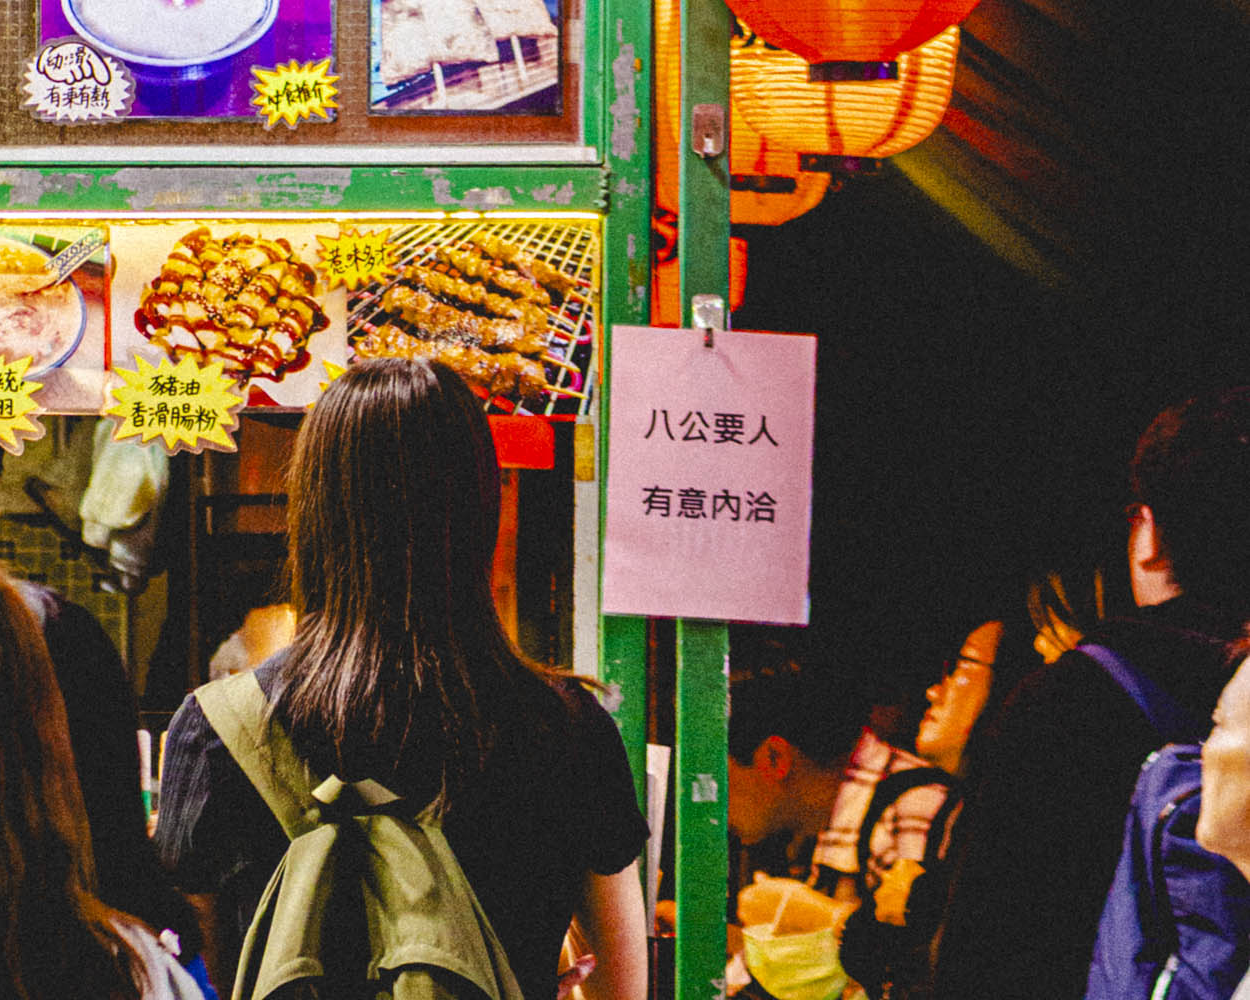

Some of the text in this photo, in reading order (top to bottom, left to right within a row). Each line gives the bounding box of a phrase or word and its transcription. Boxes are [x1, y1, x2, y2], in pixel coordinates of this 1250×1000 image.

[148, 375, 200, 397] 豬油
[131, 401, 219, 433] 香滑腸粉
[644, 408, 780, 448] 八公要人
[642, 484, 778, 524] 有意內洽
